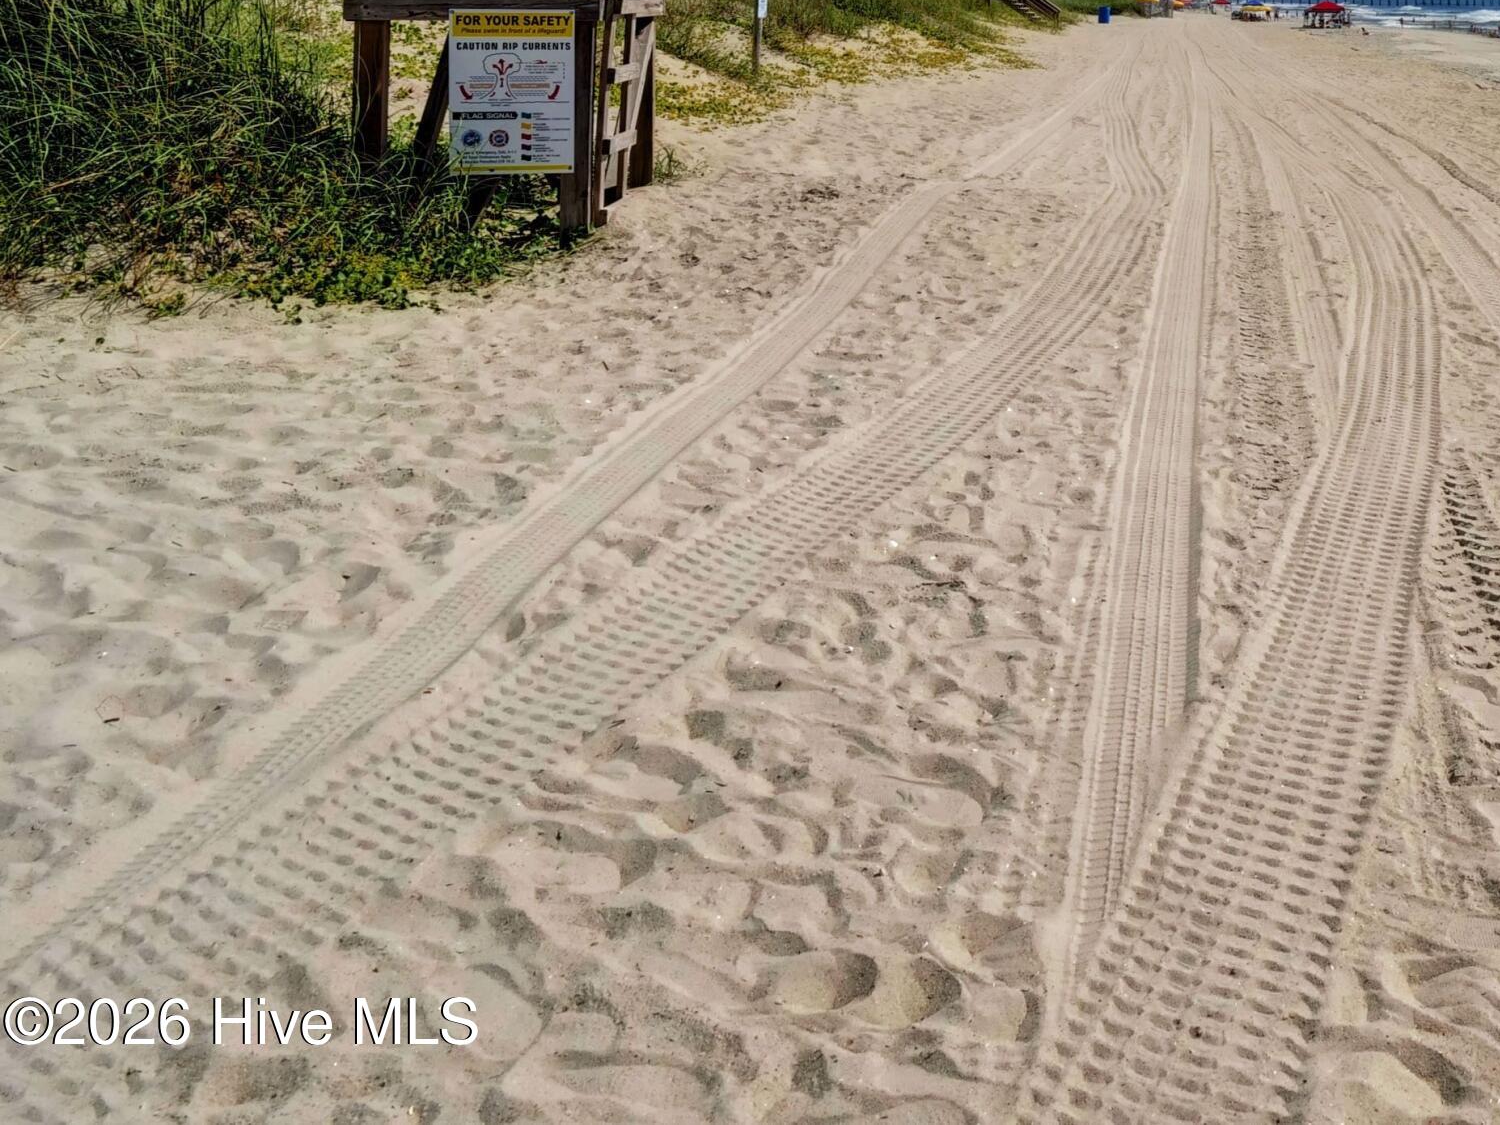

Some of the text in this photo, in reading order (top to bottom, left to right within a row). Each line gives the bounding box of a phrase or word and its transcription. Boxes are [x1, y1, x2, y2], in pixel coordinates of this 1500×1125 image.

[455, 15, 571, 26] FOR YOUR SAFETY
[456, 42, 571, 50] CAUTION RIP CURRENTS
